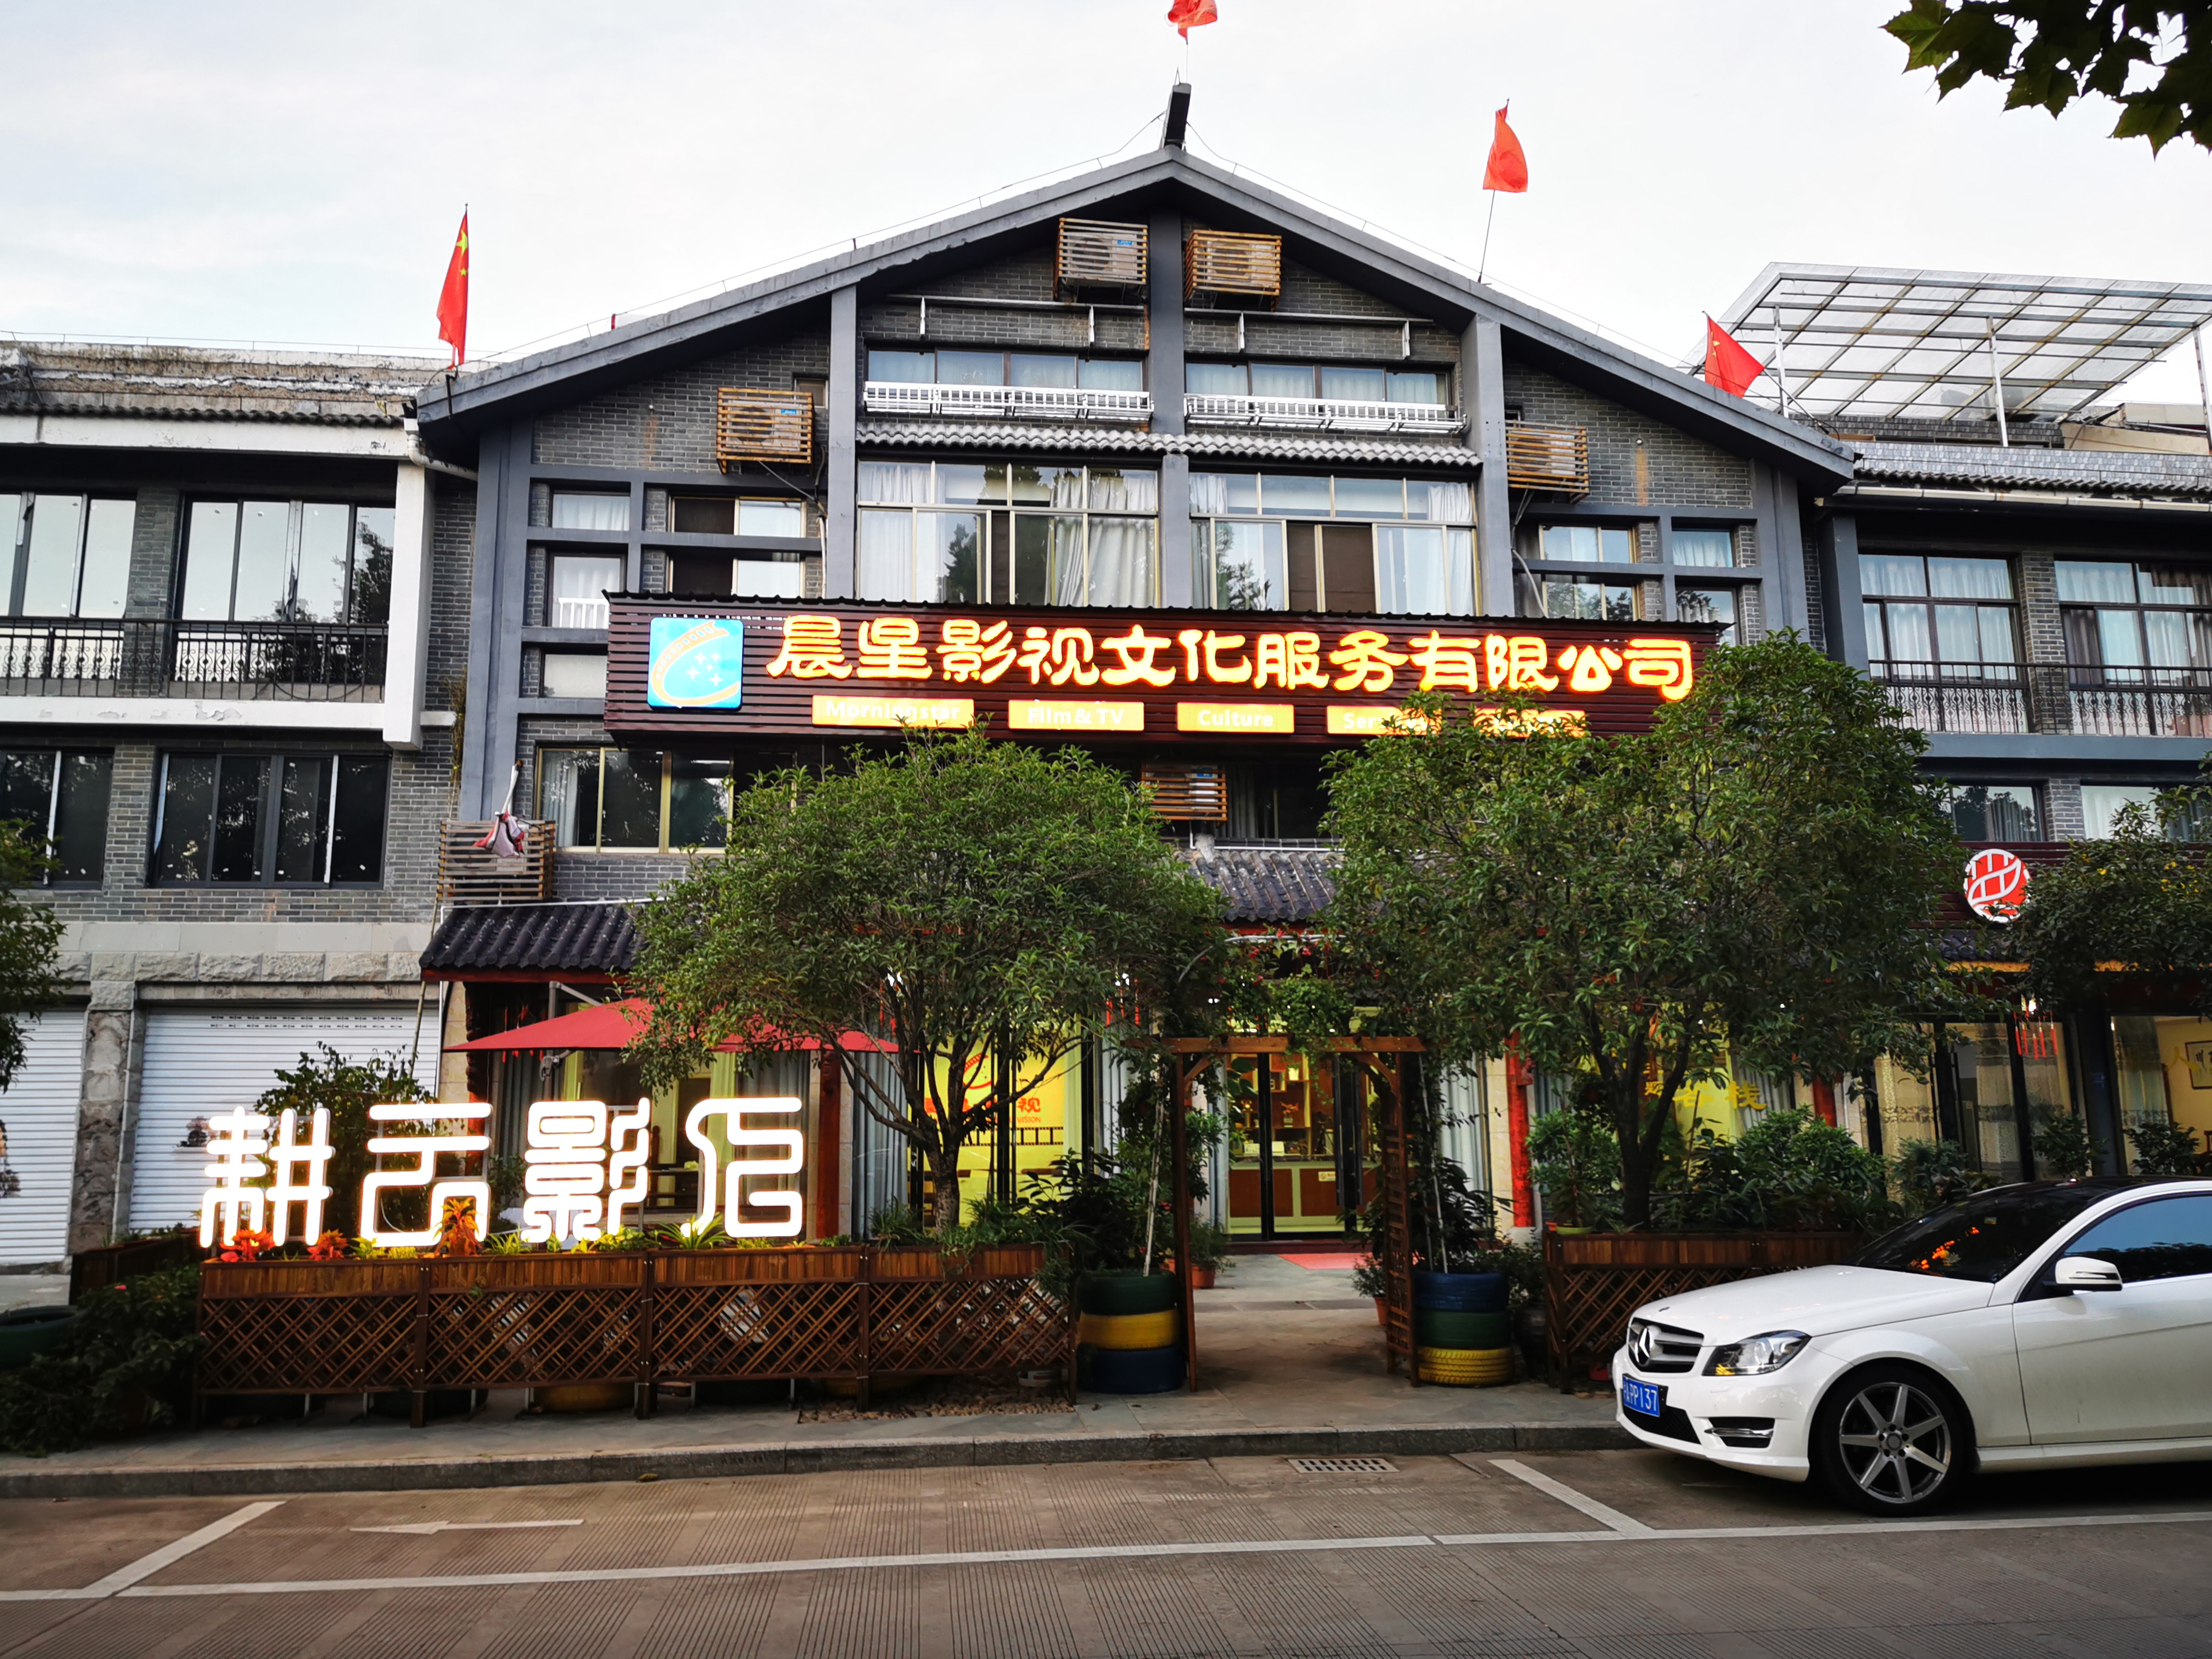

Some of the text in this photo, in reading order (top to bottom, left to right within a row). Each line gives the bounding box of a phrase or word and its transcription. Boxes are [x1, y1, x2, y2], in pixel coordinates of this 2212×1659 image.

[766, 614, 1692, 701] 晨星影视文化服务有限公司
[825, 700, 960, 723] Morningstar
[1198, 709, 1273, 727] Culture
